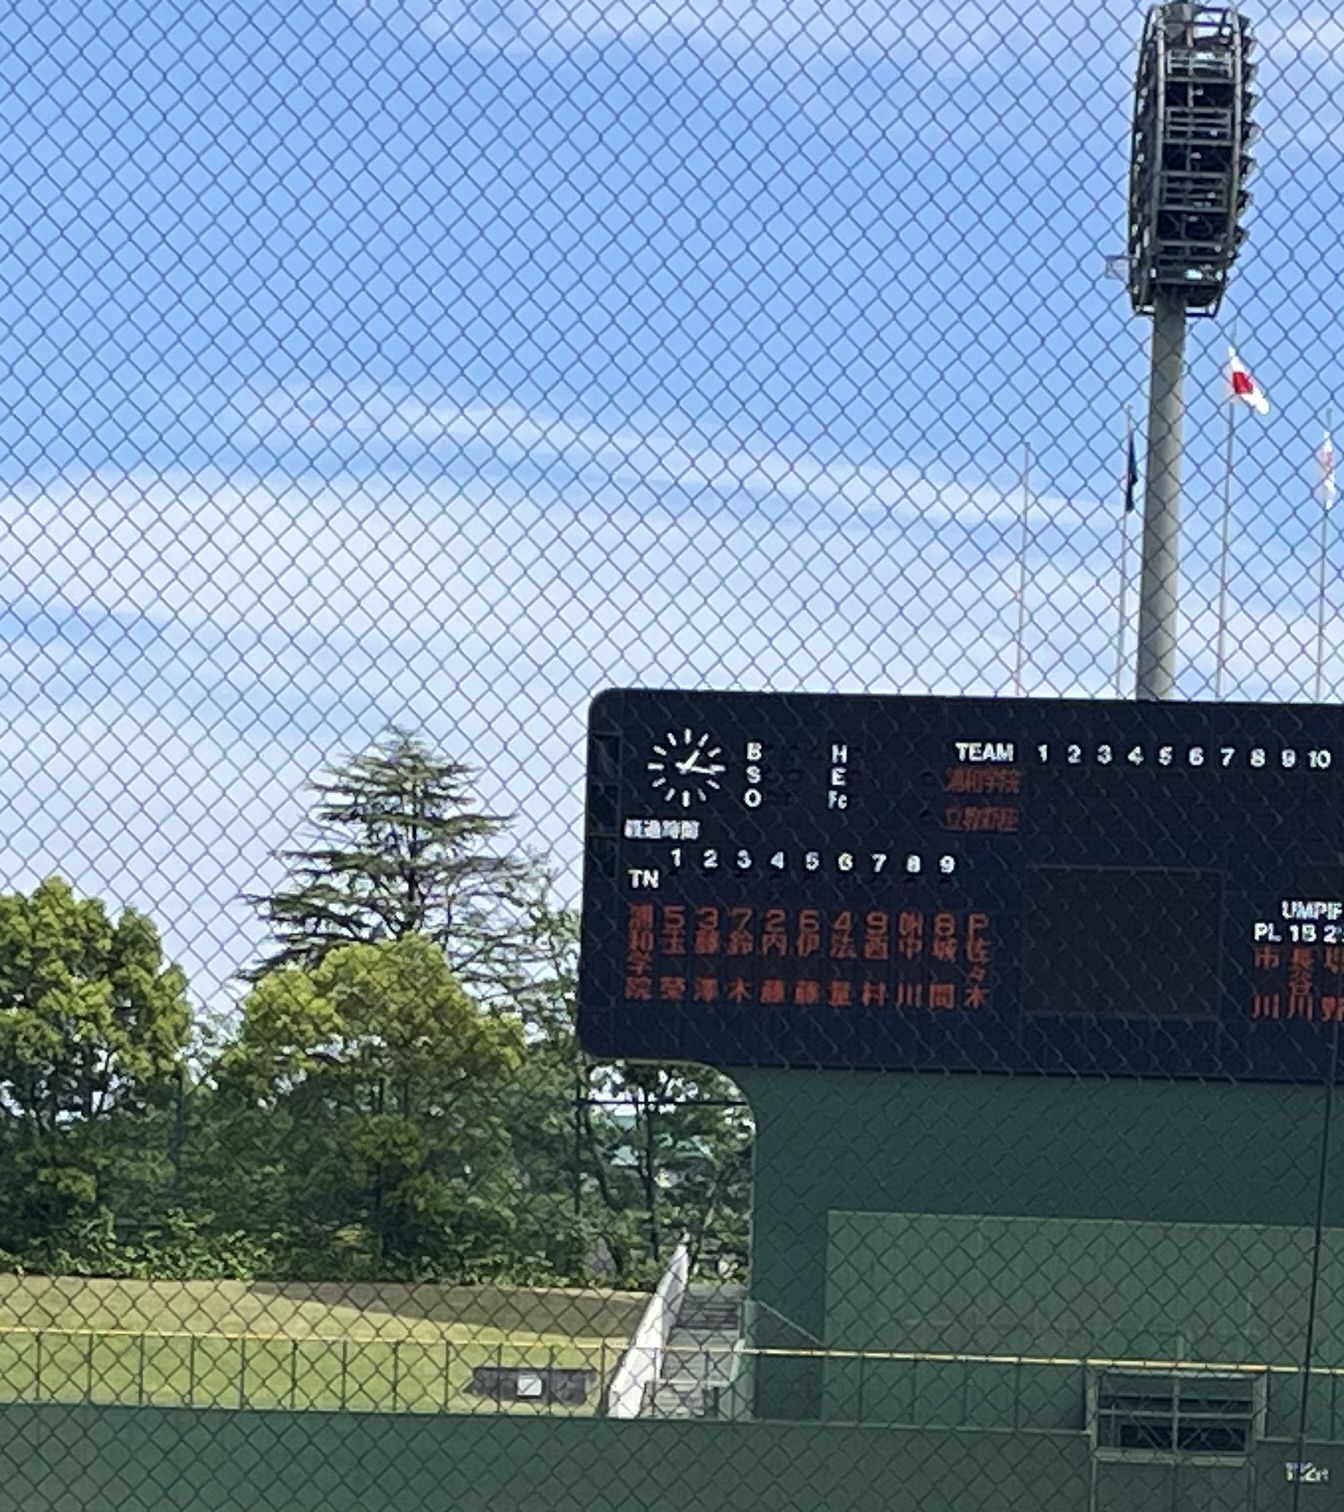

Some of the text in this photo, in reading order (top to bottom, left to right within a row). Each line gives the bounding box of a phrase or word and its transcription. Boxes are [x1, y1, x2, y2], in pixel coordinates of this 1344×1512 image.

[746, 742, 762, 761] B
[832, 744, 848, 764] H
[955, 742, 1014, 762] TEAM
[1038, 744, 1048, 762] 1
[1068, 744, 1081, 764] 2
[1097, 744, 1112, 764] 3
[1127, 746, 1144, 765] 4
[1158, 746, 1173, 766] 5
[1189, 747, 1204, 766] 6
[1220, 748, 1235, 766] 7
[1250, 748, 1266, 768] 8
[1281, 749, 1296, 768] 9
[1308, 750, 1331, 769] 10
[746, 765, 761, 784] S
[831, 767, 846, 786] E
[671, 848, 956, 874] 1 2 3 4 5 6 7 8 9
[1254, 922, 1281, 942] PL
[1289, 924, 1317, 942] 1B
